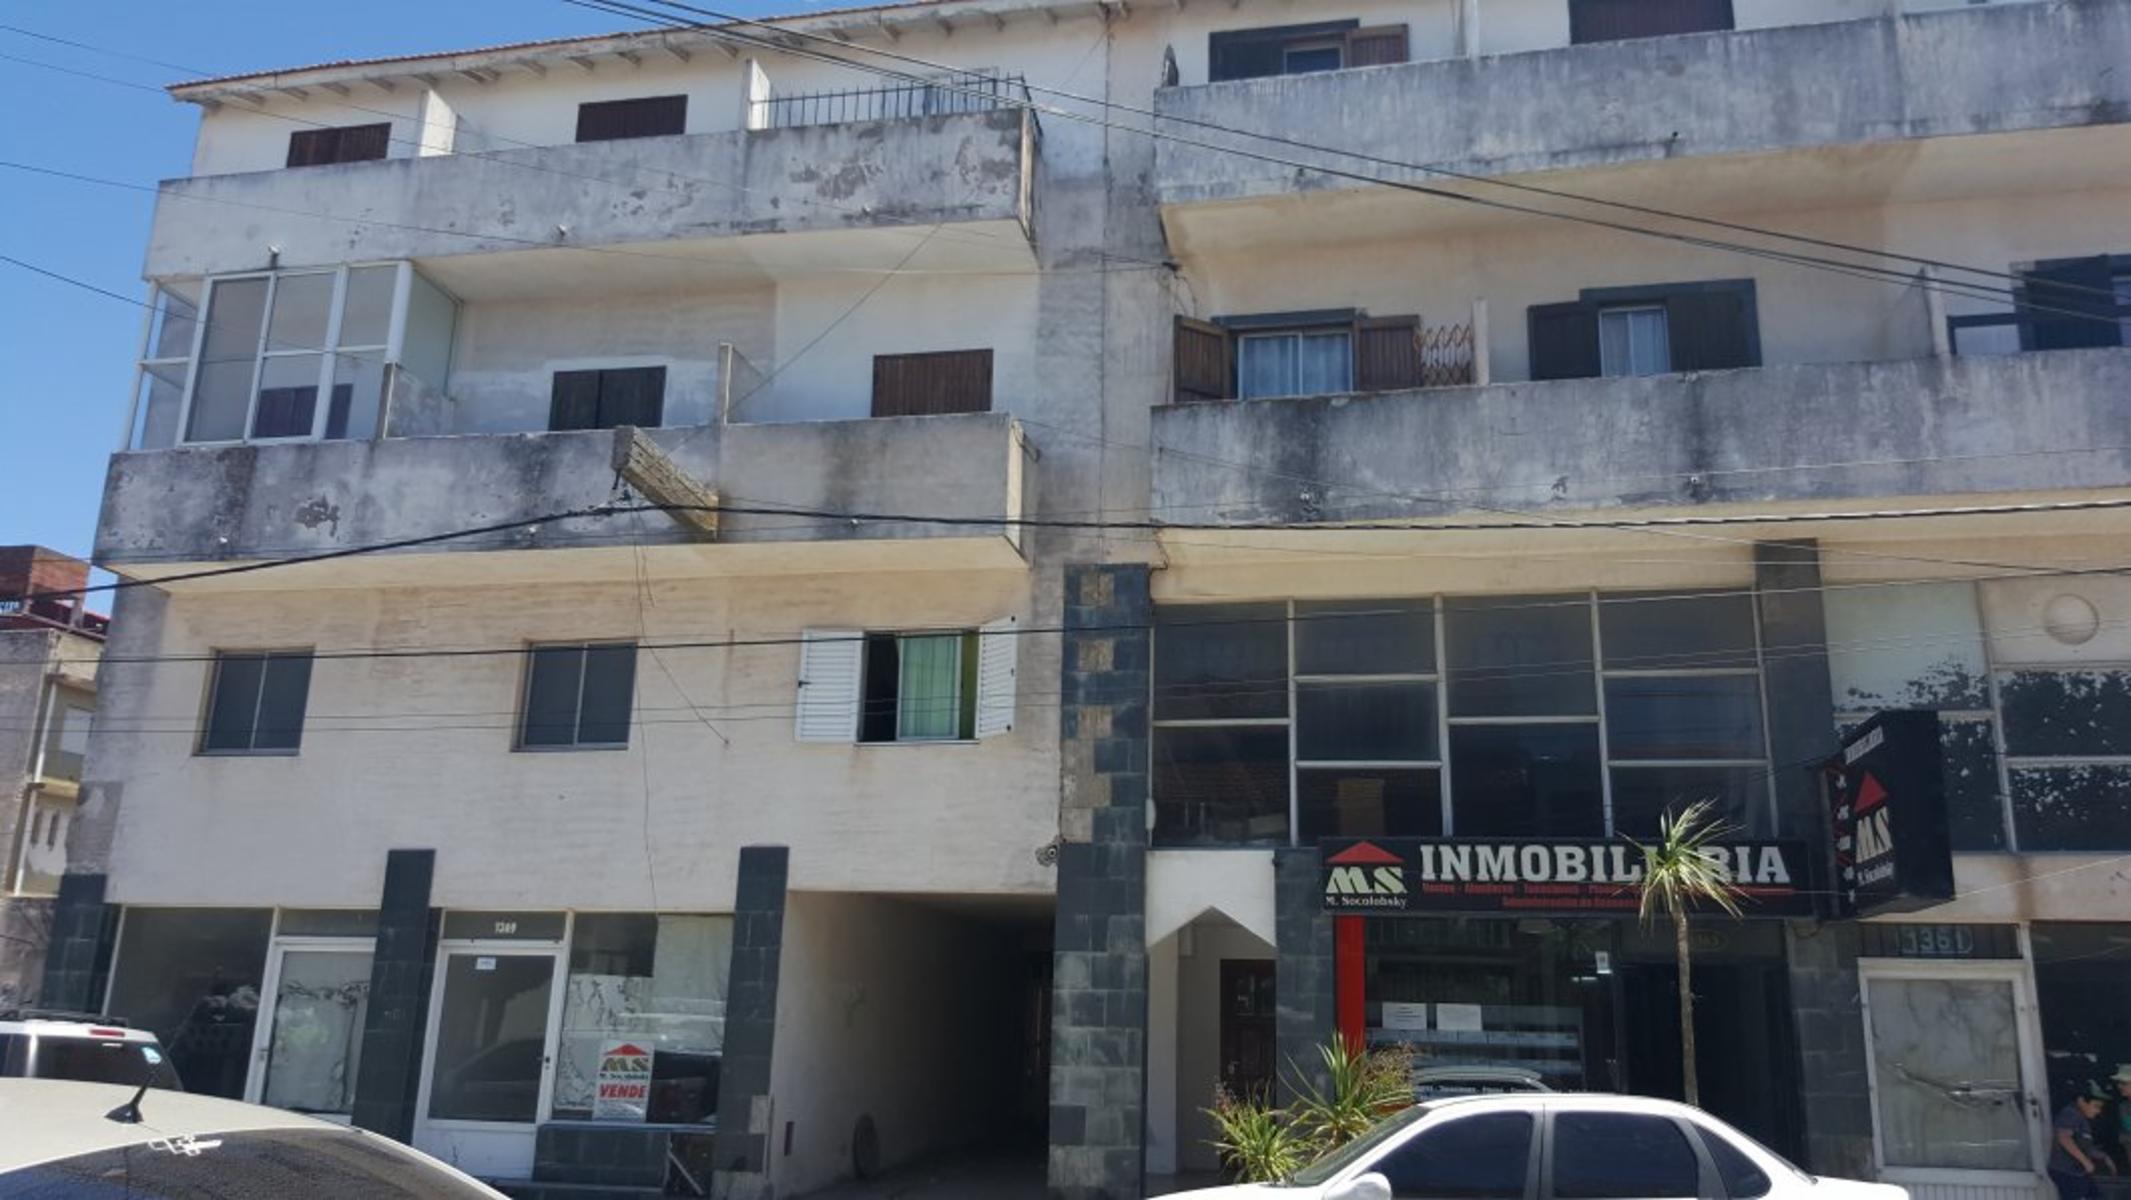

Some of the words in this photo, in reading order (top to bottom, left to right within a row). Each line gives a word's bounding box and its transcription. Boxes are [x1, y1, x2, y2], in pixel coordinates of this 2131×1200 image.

[1419, 844, 1790, 883] INMOBILRIA
[1326, 866, 1407, 893] MS
[601, 1057, 649, 1072] MS
[600, 1084, 647, 1098] VENDE
